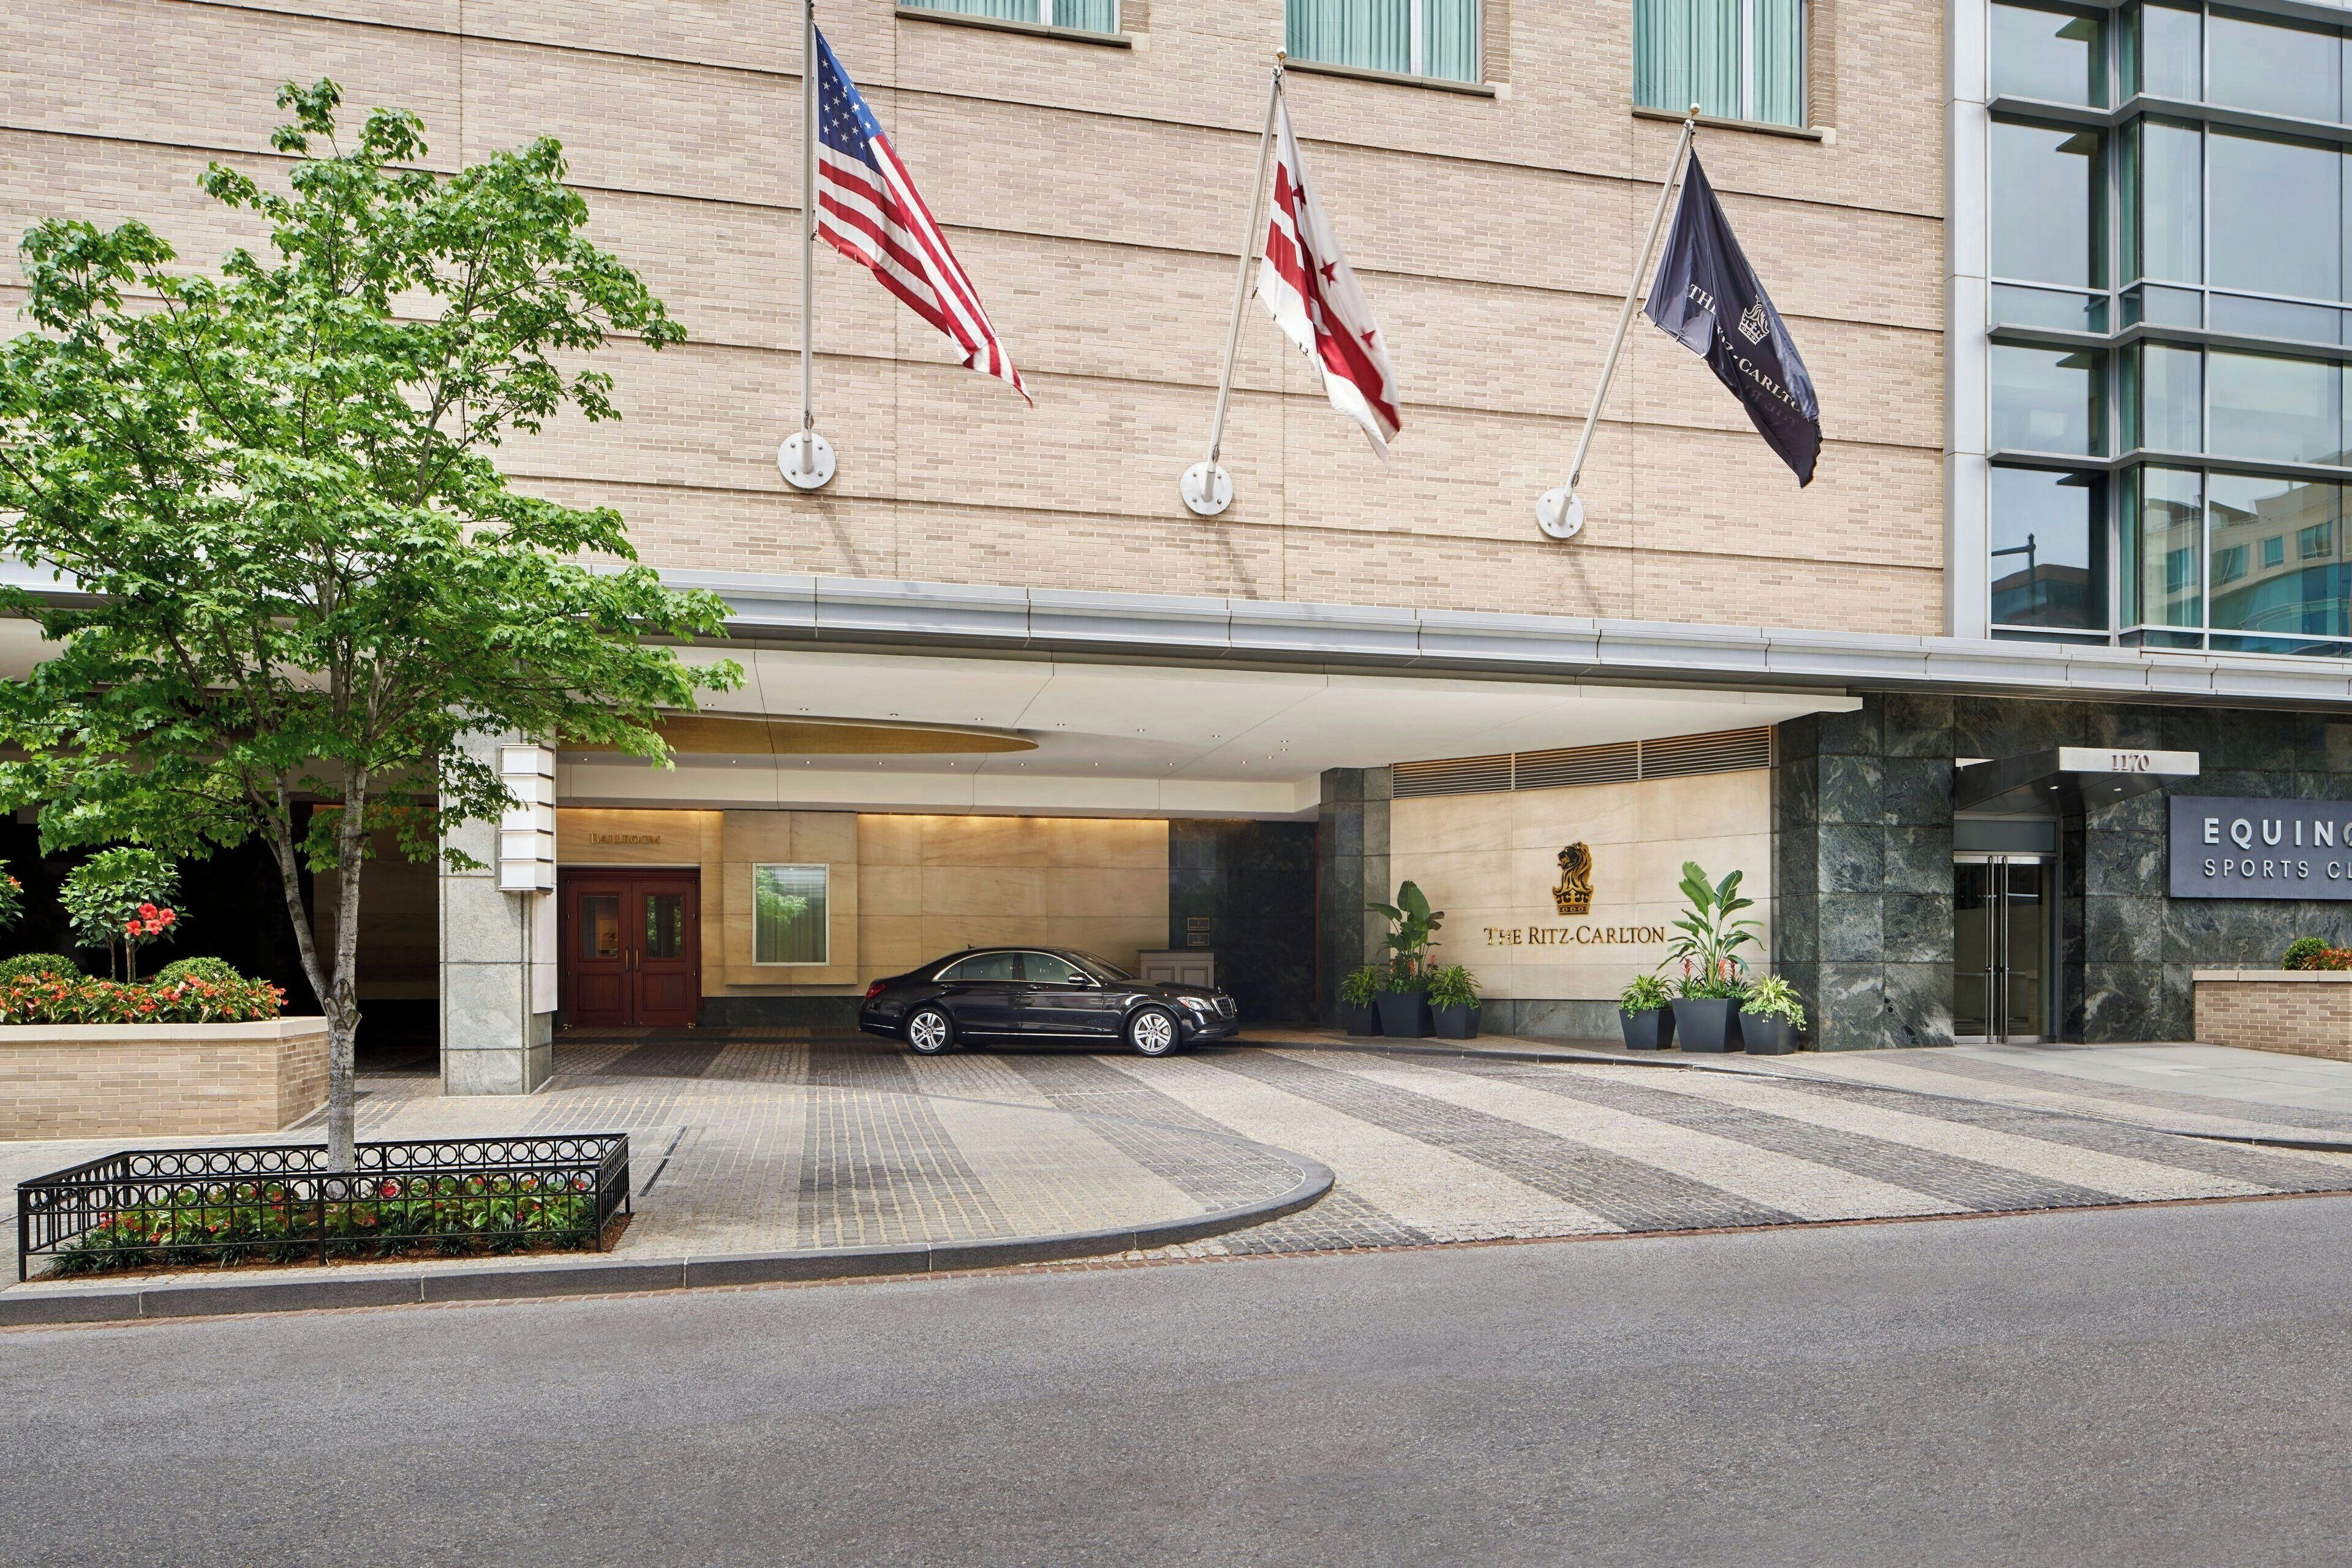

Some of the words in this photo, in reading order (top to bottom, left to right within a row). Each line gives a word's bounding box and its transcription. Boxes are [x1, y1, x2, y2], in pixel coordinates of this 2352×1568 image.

[2112, 753, 2150, 772] 1170
[589, 833, 662, 845] BALLROOM
[2204, 858, 2309, 878] SPORTS
[1483, 927, 1523, 946] THE
[1528, 925, 1665, 945] RITZ-CARLTON
